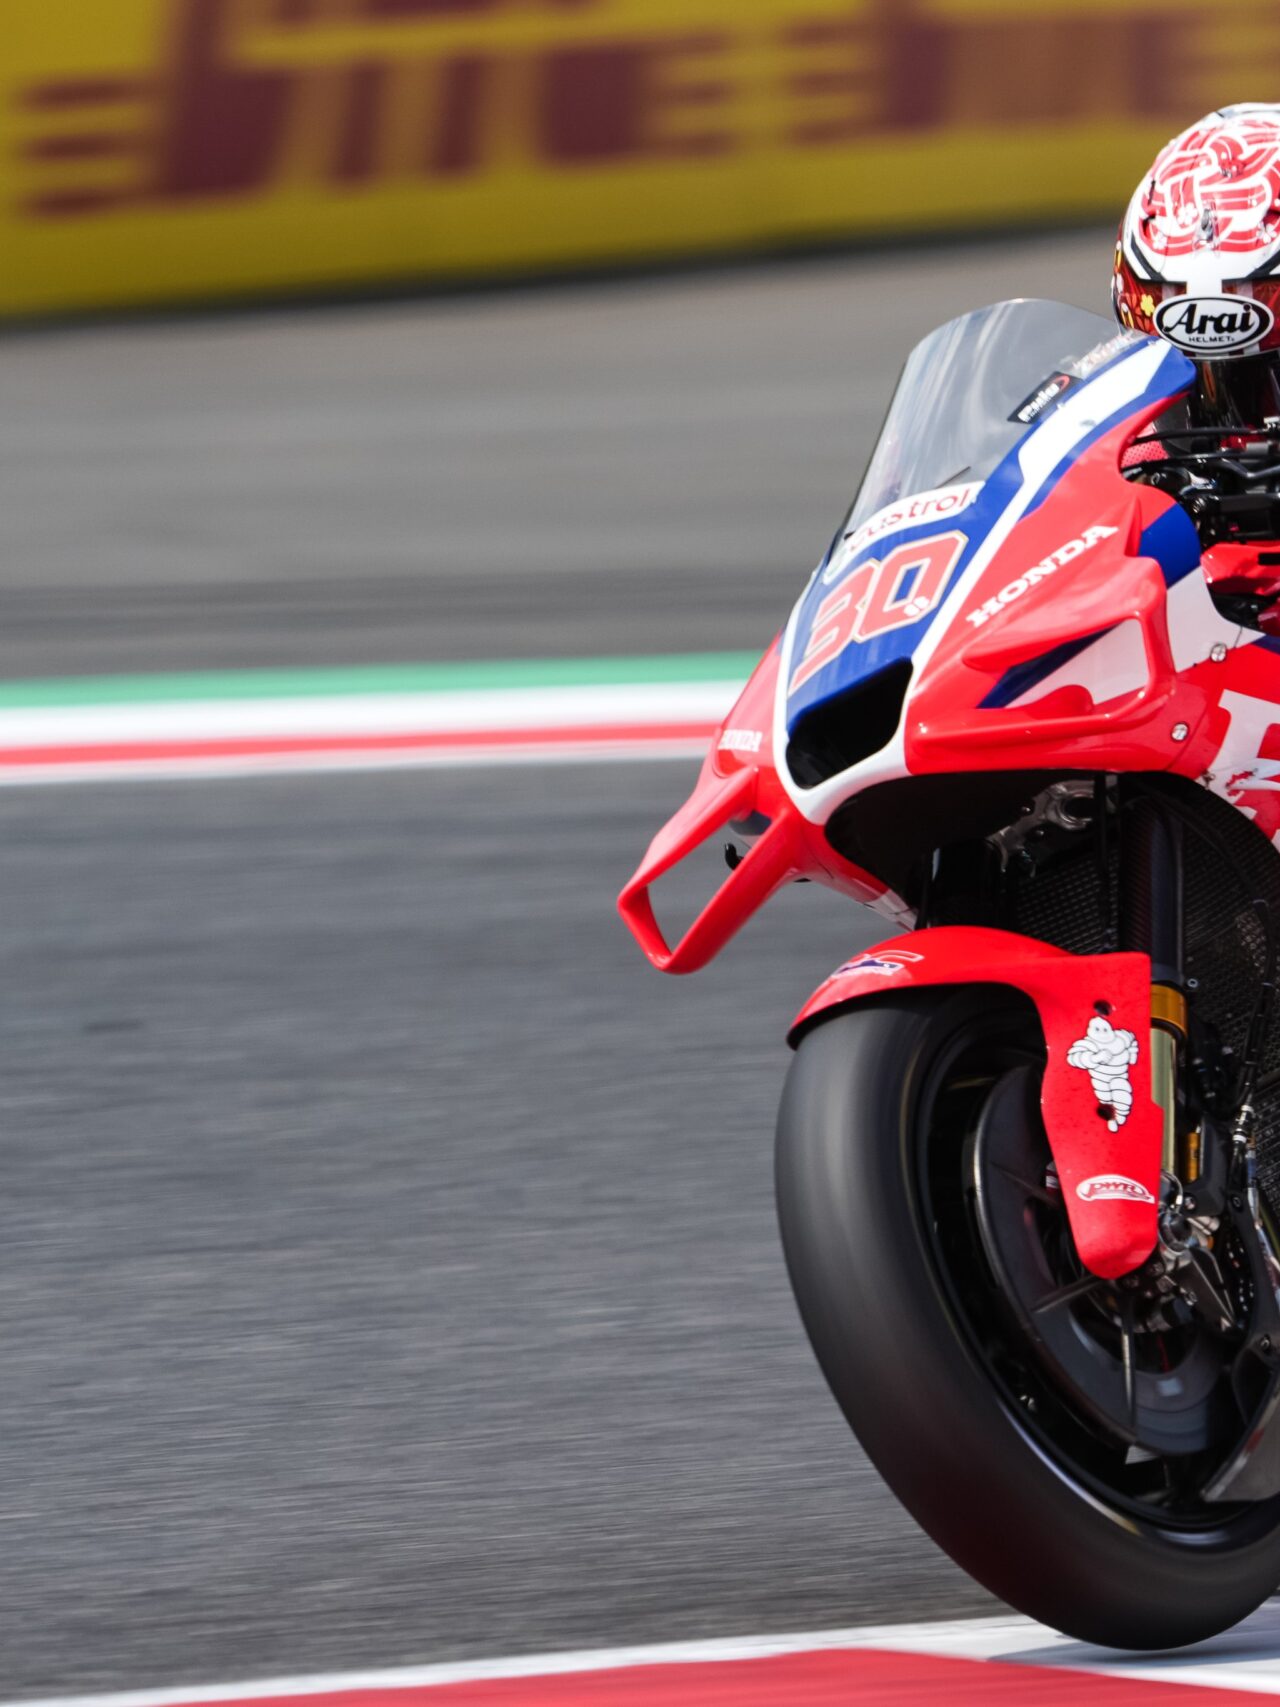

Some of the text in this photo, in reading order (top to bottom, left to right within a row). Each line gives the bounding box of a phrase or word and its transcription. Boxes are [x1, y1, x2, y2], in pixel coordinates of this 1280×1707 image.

[1162, 303, 1255, 335] Arai
[1189, 335, 1231, 343] HELMET
[966, 525, 1119, 628] HONDA
[788, 529, 969, 697] 30
